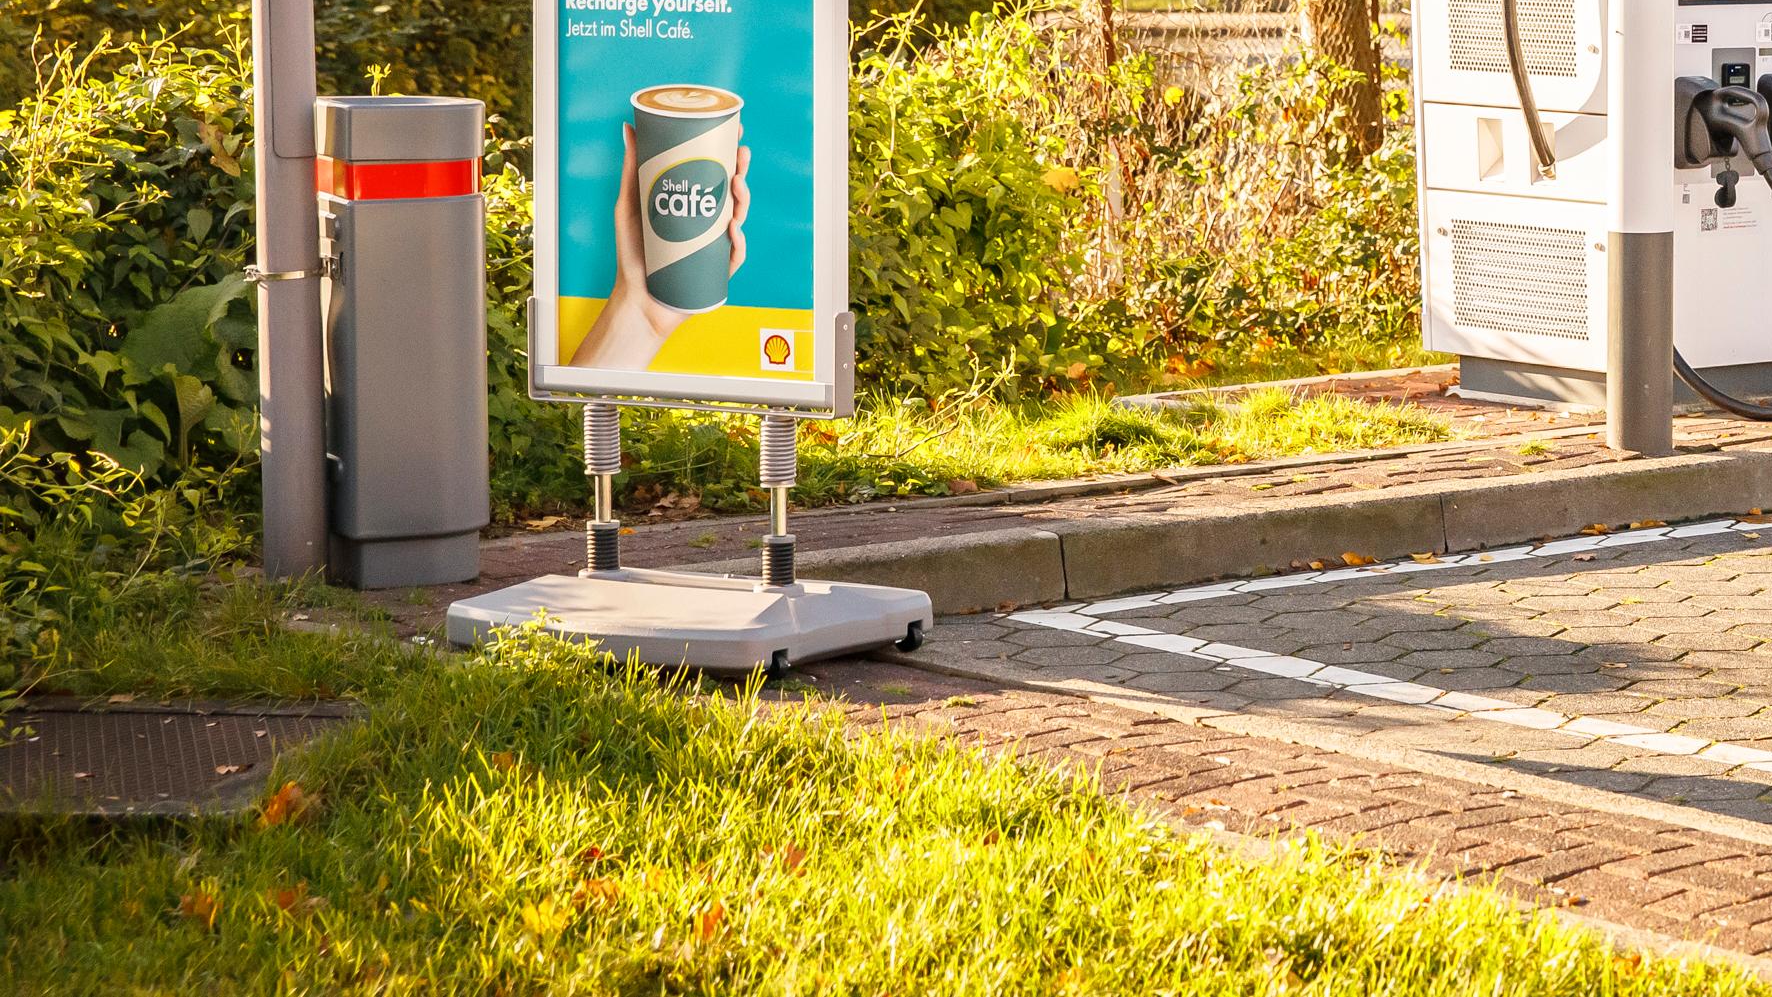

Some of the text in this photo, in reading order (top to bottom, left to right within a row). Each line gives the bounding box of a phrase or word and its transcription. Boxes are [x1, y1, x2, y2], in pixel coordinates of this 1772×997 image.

[565, 18, 694, 39] Jetzt im Shell Café.
[662, 179, 688, 192] Shell
[655, 184, 717, 218] café
